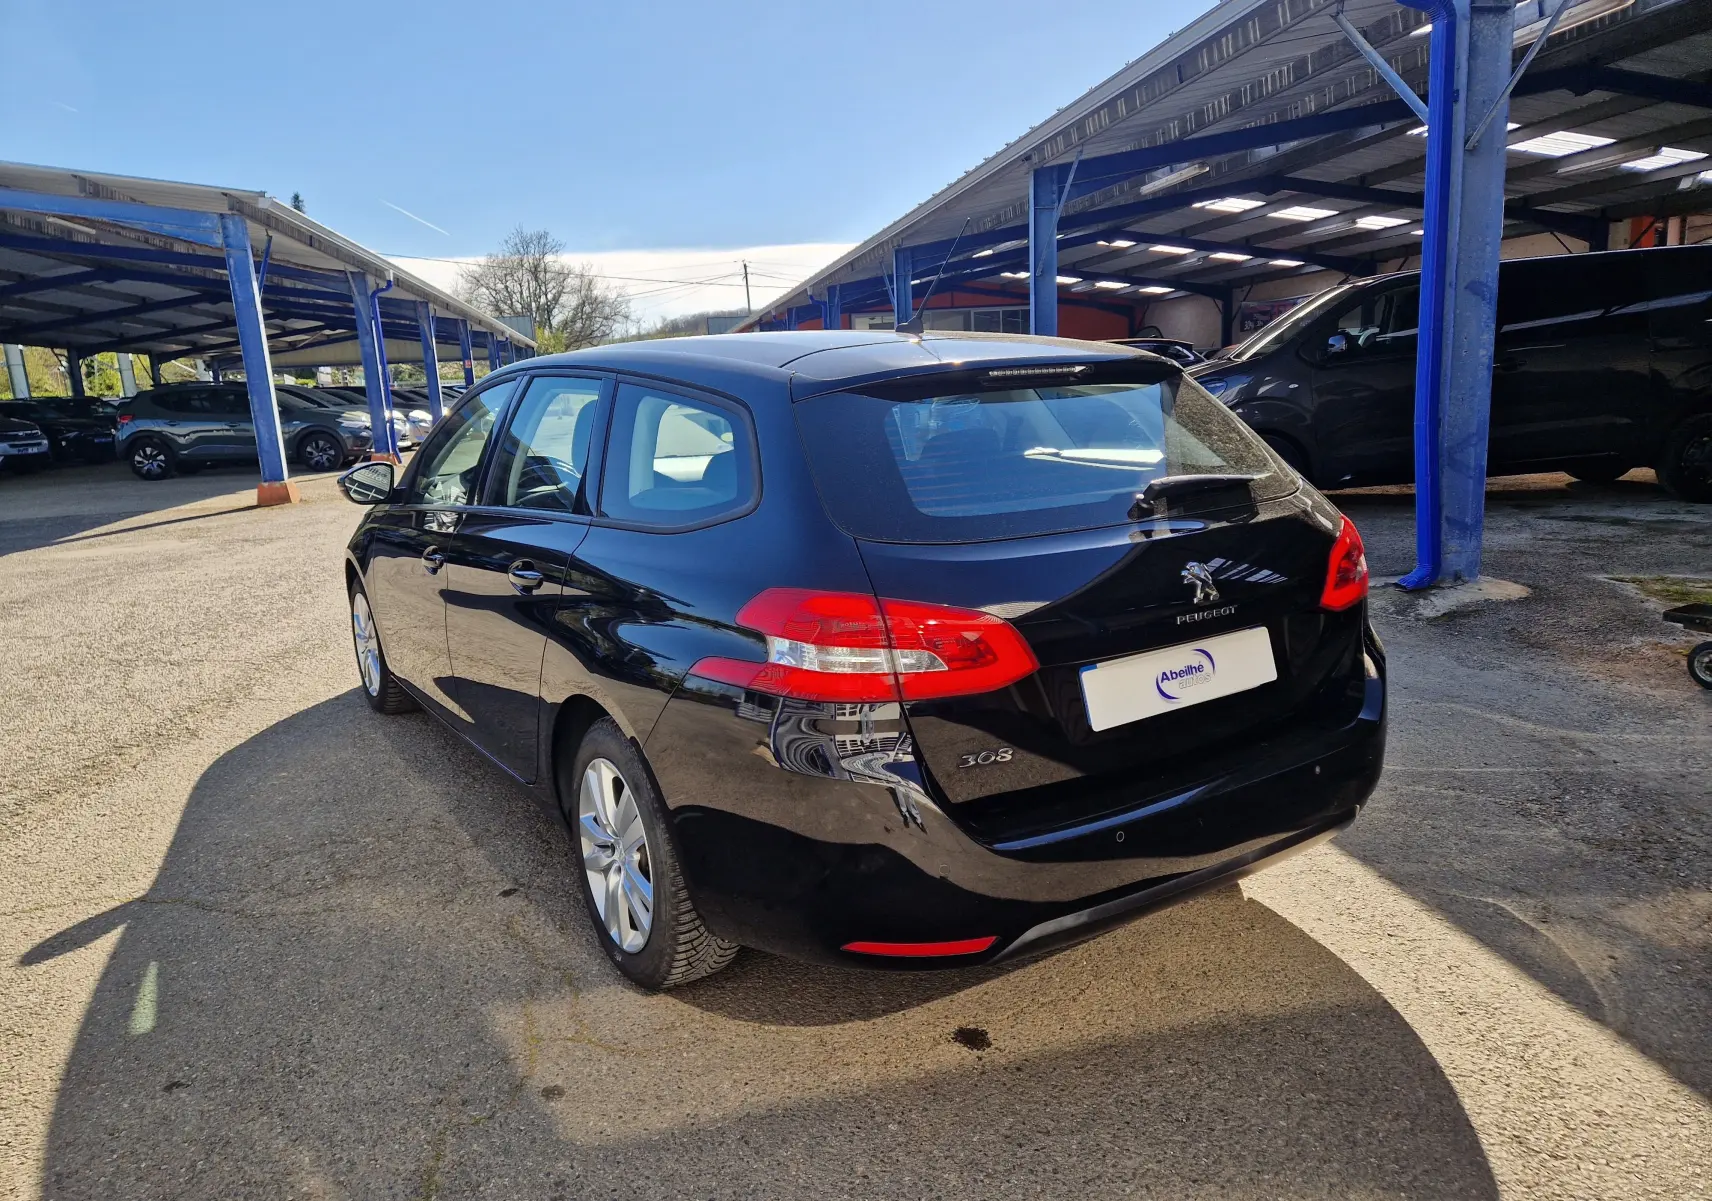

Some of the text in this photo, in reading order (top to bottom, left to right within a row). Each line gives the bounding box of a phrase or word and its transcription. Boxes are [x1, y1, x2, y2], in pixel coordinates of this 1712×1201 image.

[1176, 604, 1238, 625] PEUGEOT
[1160, 661, 1204, 684] Abeilhé
[1179, 673, 1211, 689] autos
[959, 747, 1013, 768] 308
